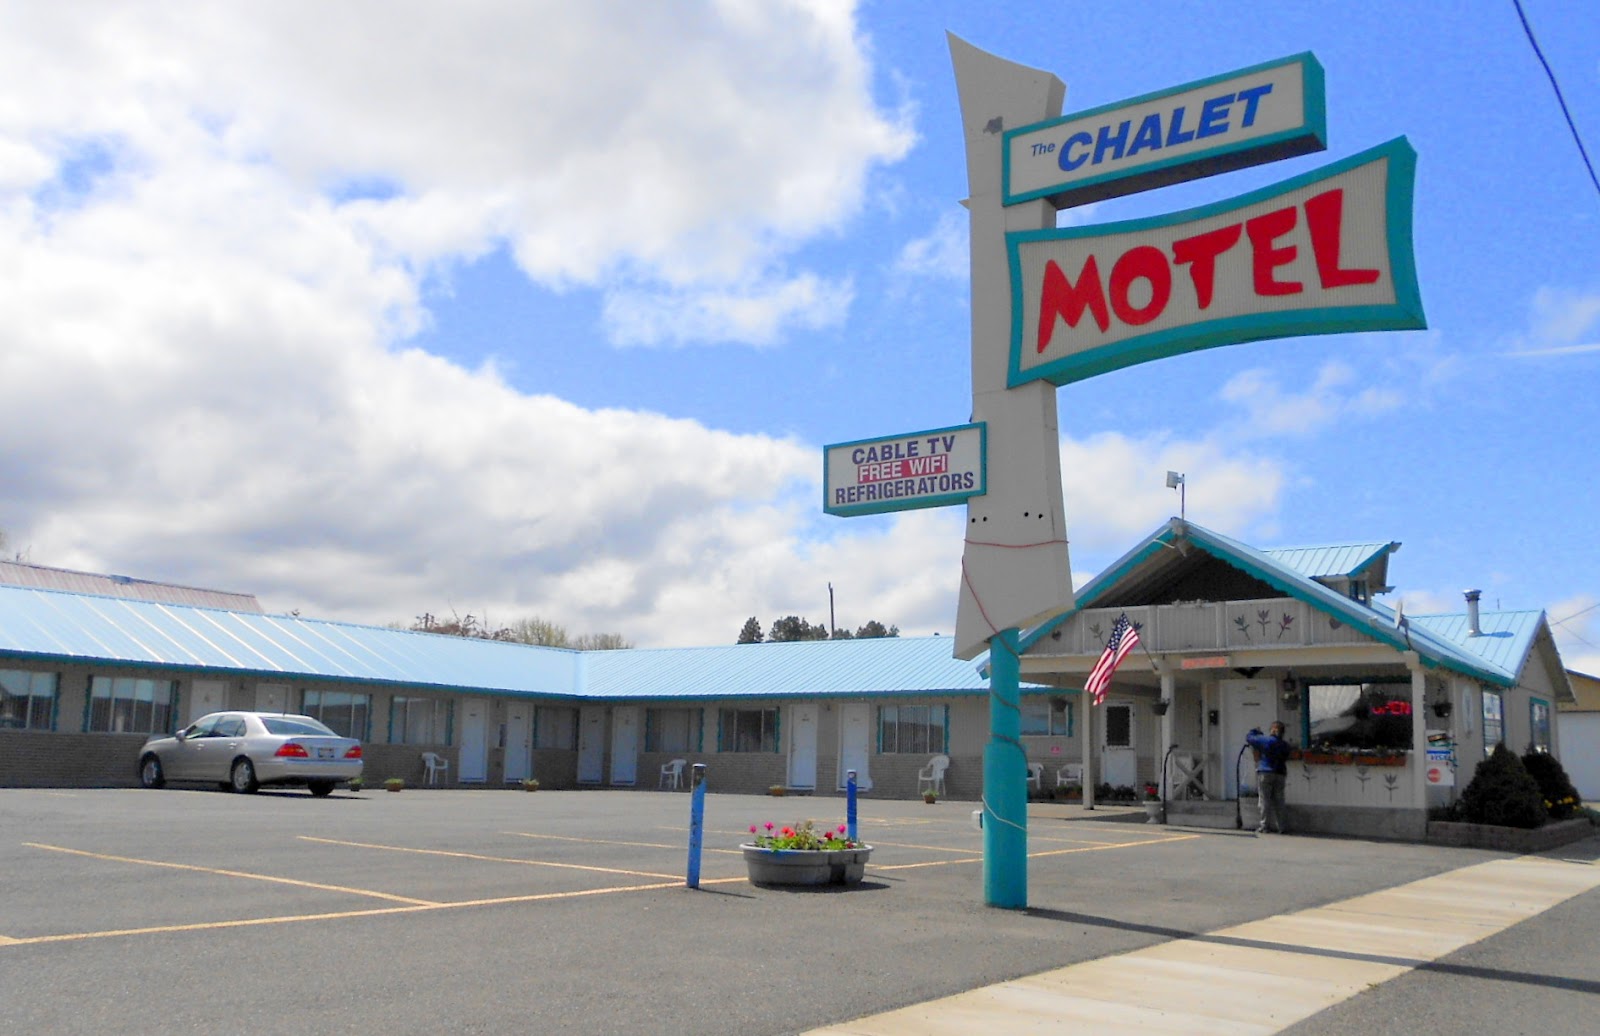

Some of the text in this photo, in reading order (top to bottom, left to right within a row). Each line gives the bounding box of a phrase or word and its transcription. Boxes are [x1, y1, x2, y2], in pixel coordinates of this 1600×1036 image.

[1031, 83, 1274, 172] The CHALET
[1037, 188, 1381, 354] MOTEL
[852, 435, 955, 465] CABLE TV
[859, 455, 946, 482] FREE WIFI
[835, 471, 974, 504] REFRIGERATORS
